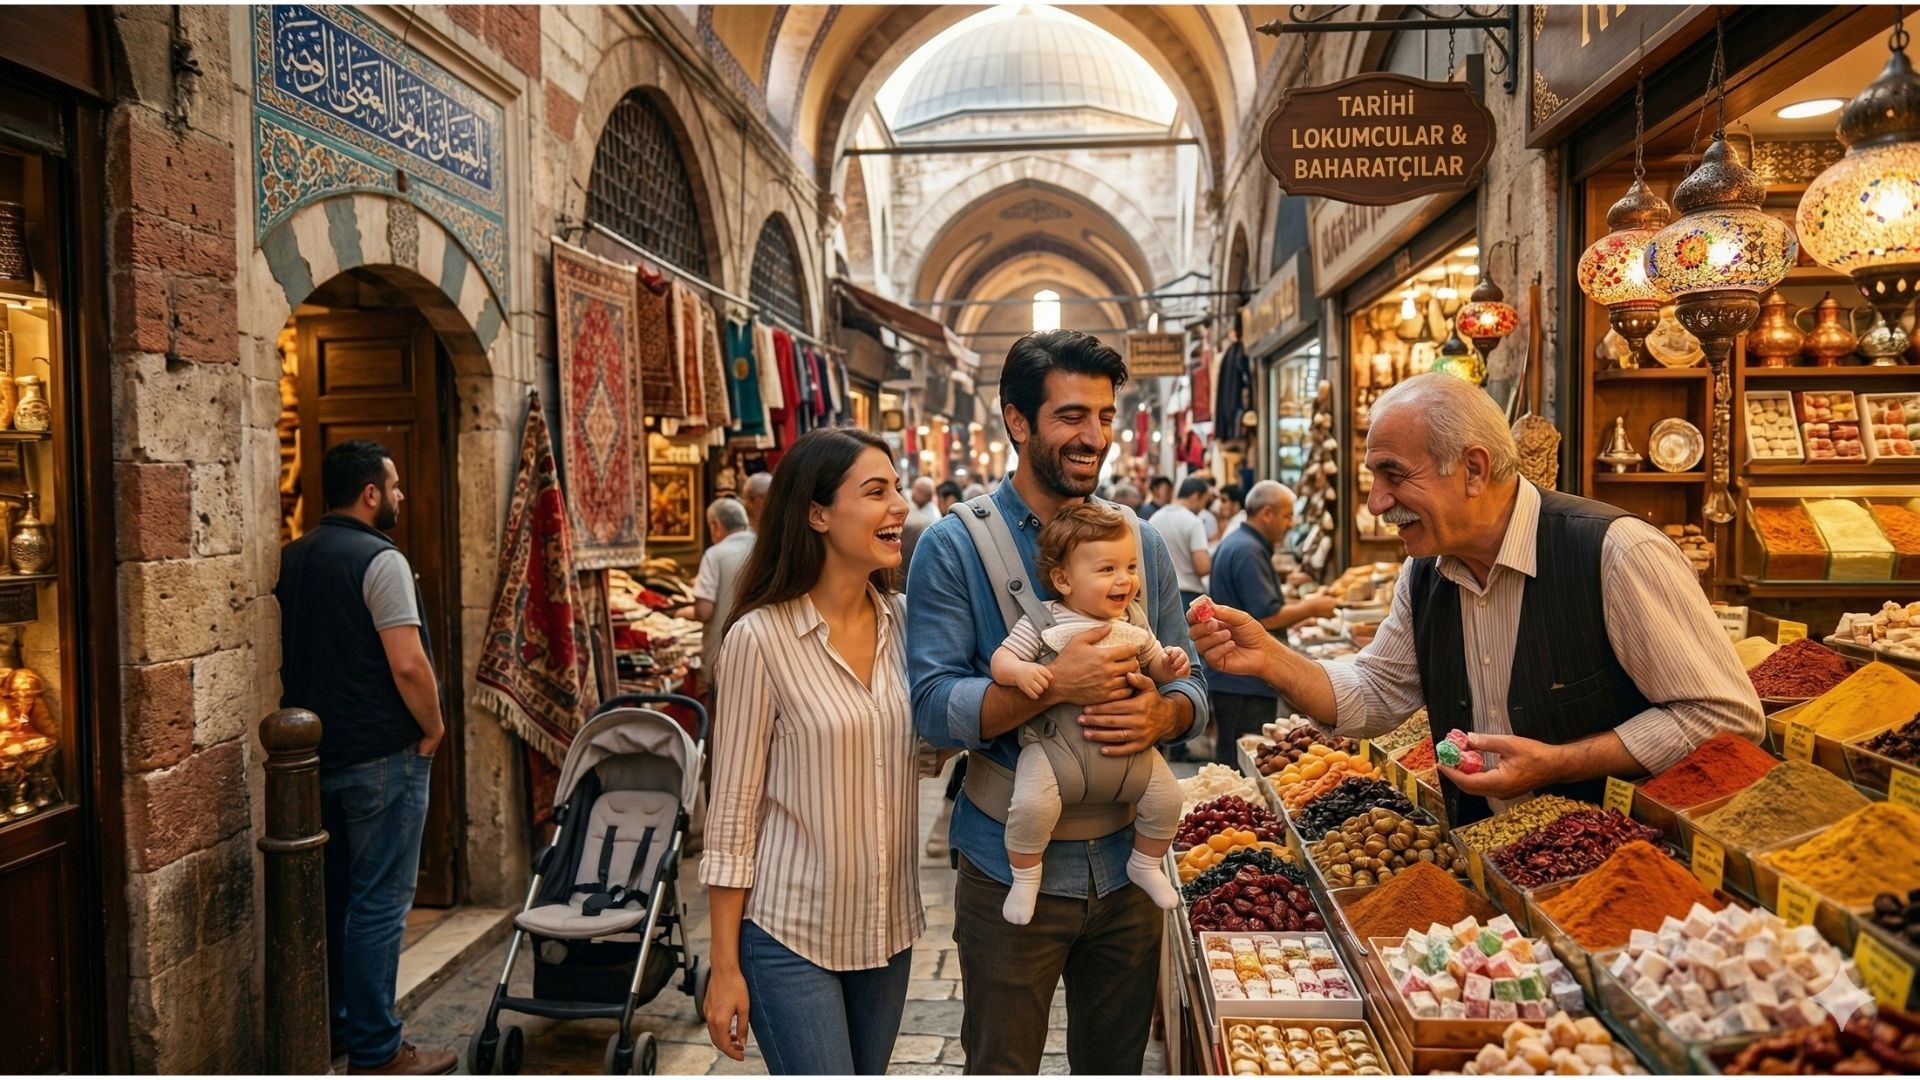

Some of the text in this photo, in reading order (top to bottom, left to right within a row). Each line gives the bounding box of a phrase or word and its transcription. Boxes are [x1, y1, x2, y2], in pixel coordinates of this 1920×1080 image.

[1338, 89, 1413, 116] TARİHİ
[1292, 125, 1466, 149] LOKUMCULAR &
[1295, 156, 1463, 181] BAHARATÇILAR
